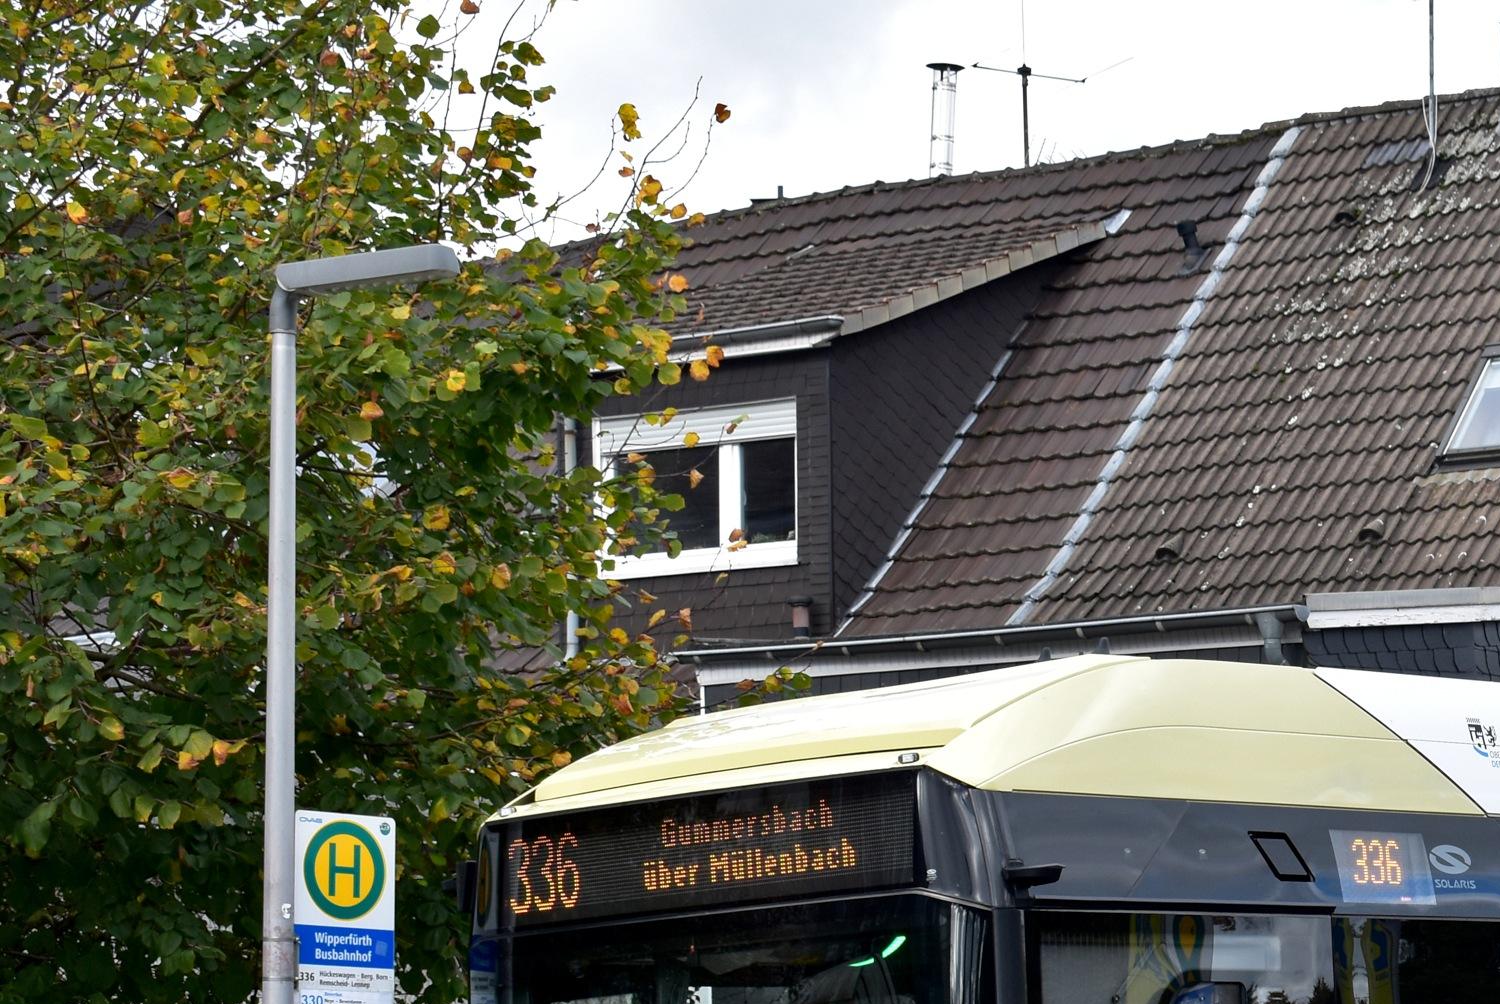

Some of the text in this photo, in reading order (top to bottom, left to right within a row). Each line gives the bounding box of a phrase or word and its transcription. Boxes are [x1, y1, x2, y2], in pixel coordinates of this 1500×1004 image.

[660, 799, 833, 848] Gummersbach
[328, 842, 361, 898] H
[507, 832, 580, 914] 336
[643, 837, 856, 890] über Müllenbach
[1352, 838, 1402, 885] 336
[1434, 878, 1477, 890] SOLARIS
[314, 931, 372, 947] Wipperfürth
[315, 948, 372, 962] Busbahnhof
[300, 971, 315, 982] 336
[319, 971, 356, 980] Hückeswagen
